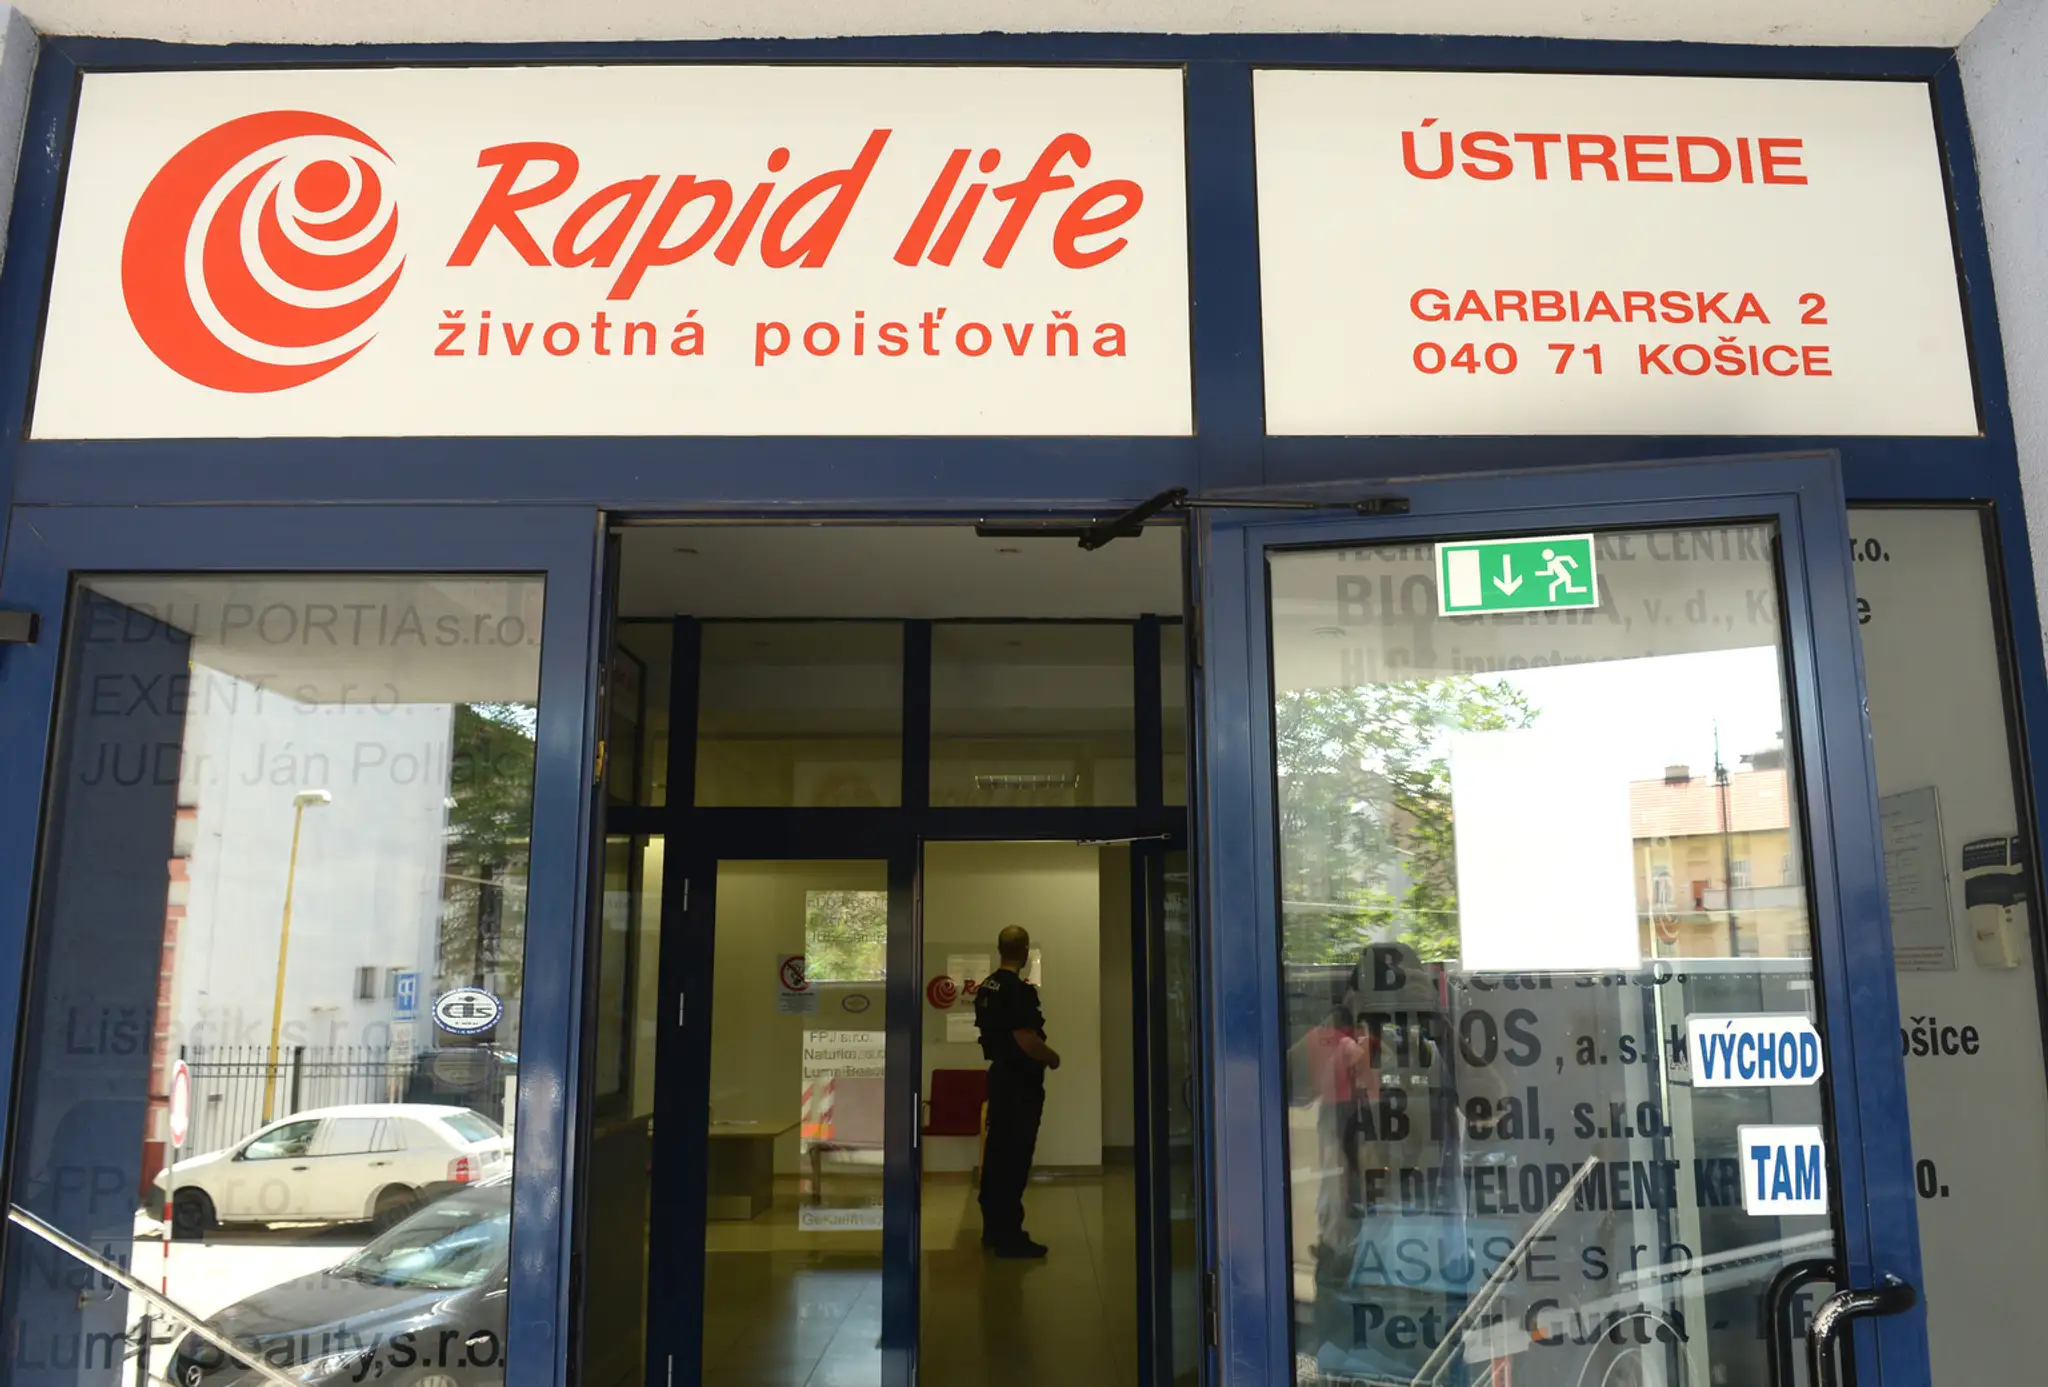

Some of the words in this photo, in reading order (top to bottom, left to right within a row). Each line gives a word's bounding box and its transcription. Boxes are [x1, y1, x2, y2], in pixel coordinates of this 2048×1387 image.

[1401, 118, 1808, 185] ÚSTREDIE
[446, 129, 893, 300] Rapid
[893, 132, 1143, 269] life
[1410, 288, 1770, 324] GARBIARSKA
[1799, 293, 1828, 324] 2
[434, 309, 705, 357] životná
[754, 308, 1127, 367] poisťovňa
[1413, 342, 1518, 375] 040
[1548, 344, 1603, 374] 71
[1639, 336, 1832, 376] KOŠICE
[220, 602, 428, 647] PORTIA
[89, 673, 278, 717] EXENT
[80, 742, 218, 787] JUDr.
[240, 740, 328, 786] Ján
[1699, 1020, 1819, 1080] VÝCHOD
[1901, 1015, 1980, 1058] šice
[1750, 1145, 1821, 1202] TAM
[1352, 1236, 1559, 1287] ASUSE
